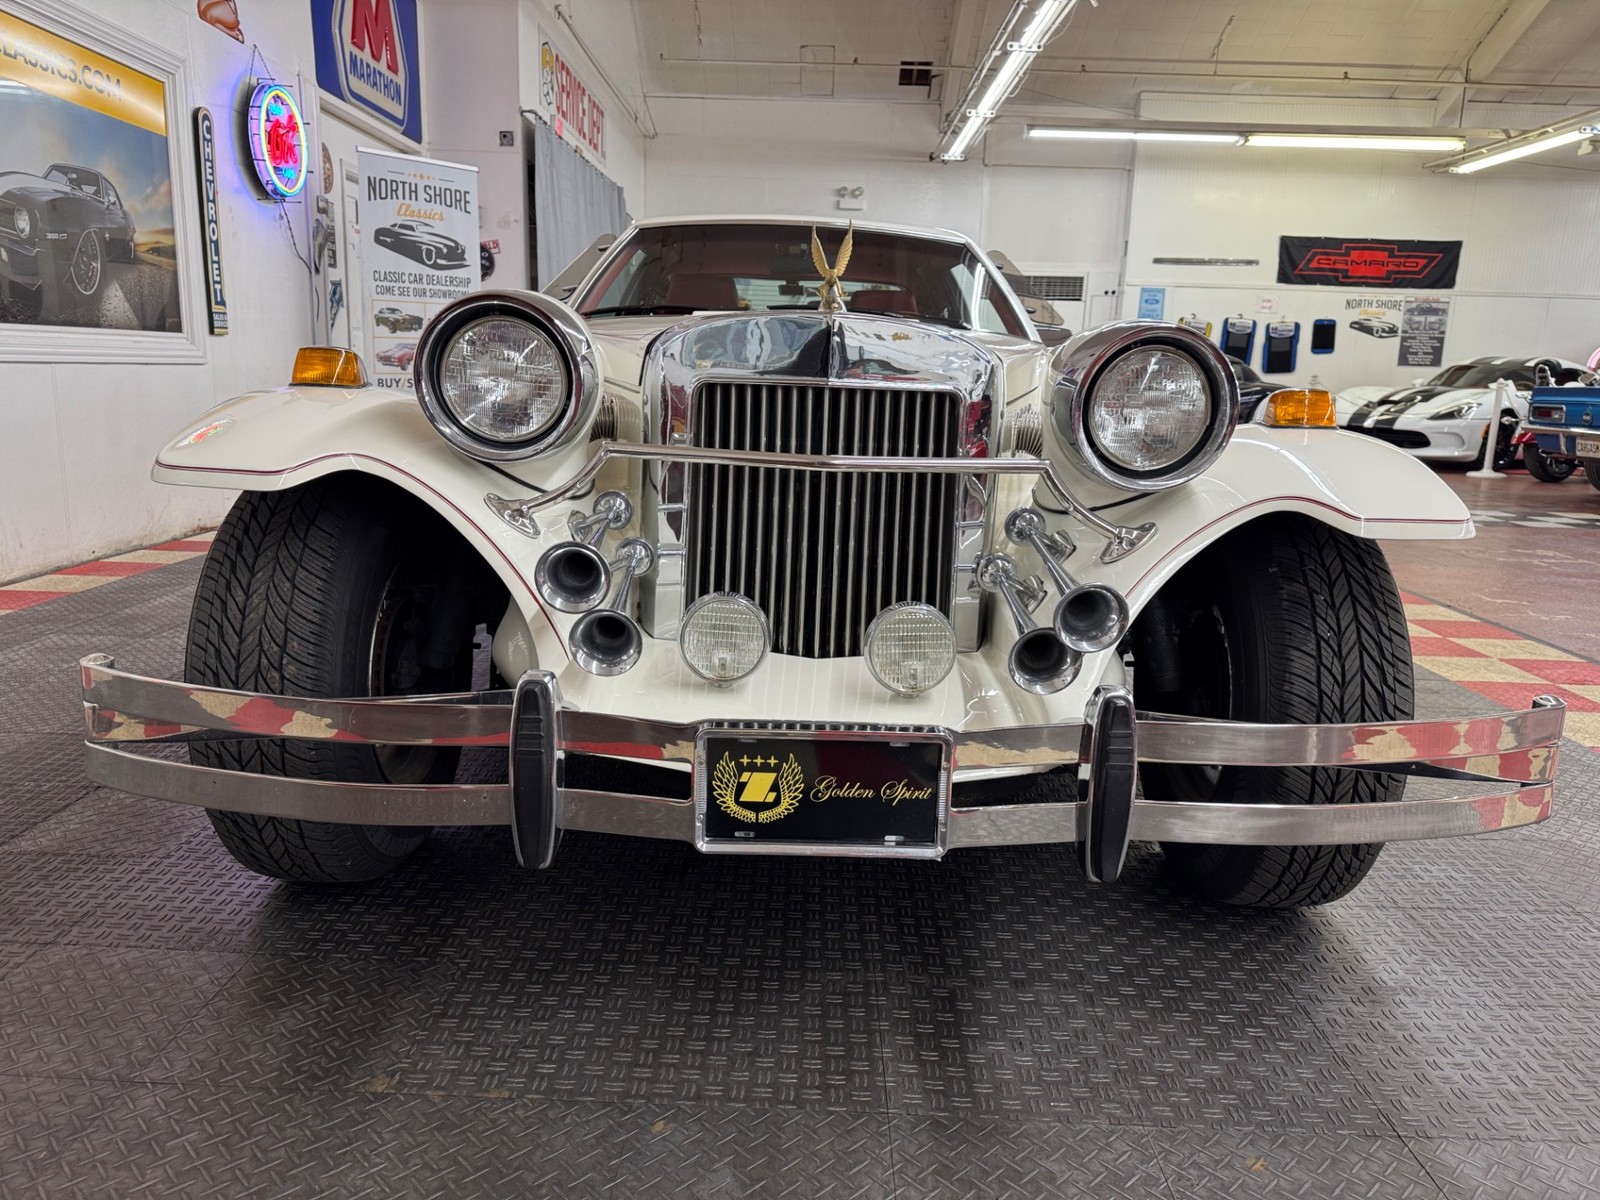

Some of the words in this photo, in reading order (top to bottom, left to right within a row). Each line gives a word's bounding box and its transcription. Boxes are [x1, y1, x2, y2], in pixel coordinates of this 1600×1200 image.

[350, 50, 402, 106] MARATHON
[555, 52, 586, 140] SERVICE
[587, 93, 606, 161] DEPT.
[367, 175, 419, 202] NORTH
[423, 184, 471, 215] SHORE
[202, 119, 222, 302] CHEVROLET
[396, 202, 445, 221] Classics
[1317, 257, 1419, 269] CAMARO
[373, 270, 406, 284] CLASSIC
[407, 273, 425, 286] CAR
[426, 273, 472, 289] DEALERSHIP
[375, 284, 396, 297] COME
[397, 286, 412, 298] SEE
[412, 288, 428, 299] OUR
[1345, 298, 1374, 311] NORTH
[1375, 299, 1404, 312] SHORE
[810, 775, 875, 803] Golden
[880, 779, 932, 807] Spirit
